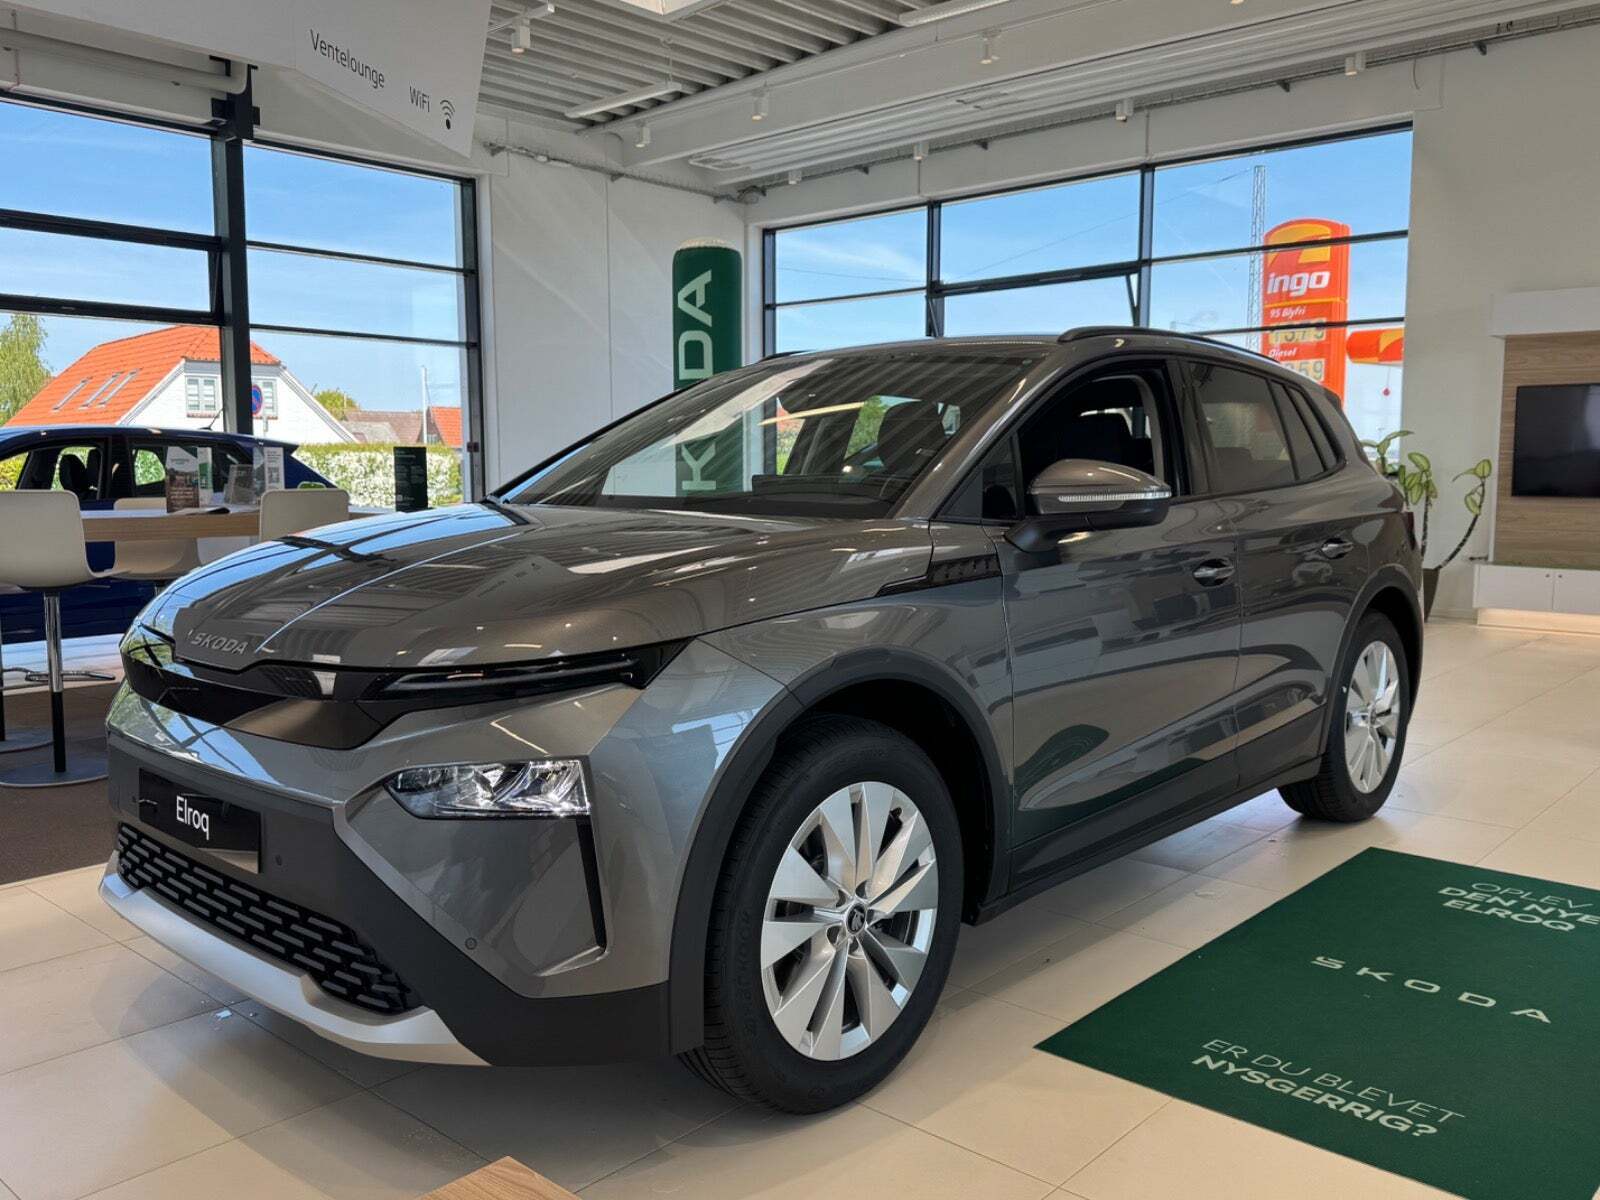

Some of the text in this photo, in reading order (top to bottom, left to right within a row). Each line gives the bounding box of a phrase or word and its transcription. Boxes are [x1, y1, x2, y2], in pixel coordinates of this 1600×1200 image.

[309, 28, 430, 113] Ventelounge WiFi
[1267, 271, 1331, 297] ingo
[1270, 308, 1281, 319] 95
[175, 794, 210, 841] Elroq
[1437, 886, 1600, 925] DEN NYE
[1471, 882, 1594, 909] OPLEV
[1442, 899, 1576, 932] ELROQ
[1191, 1054, 1439, 1137] NYSGERRIG?
[1202, 1039, 1465, 1123] ER DU BLEVET
